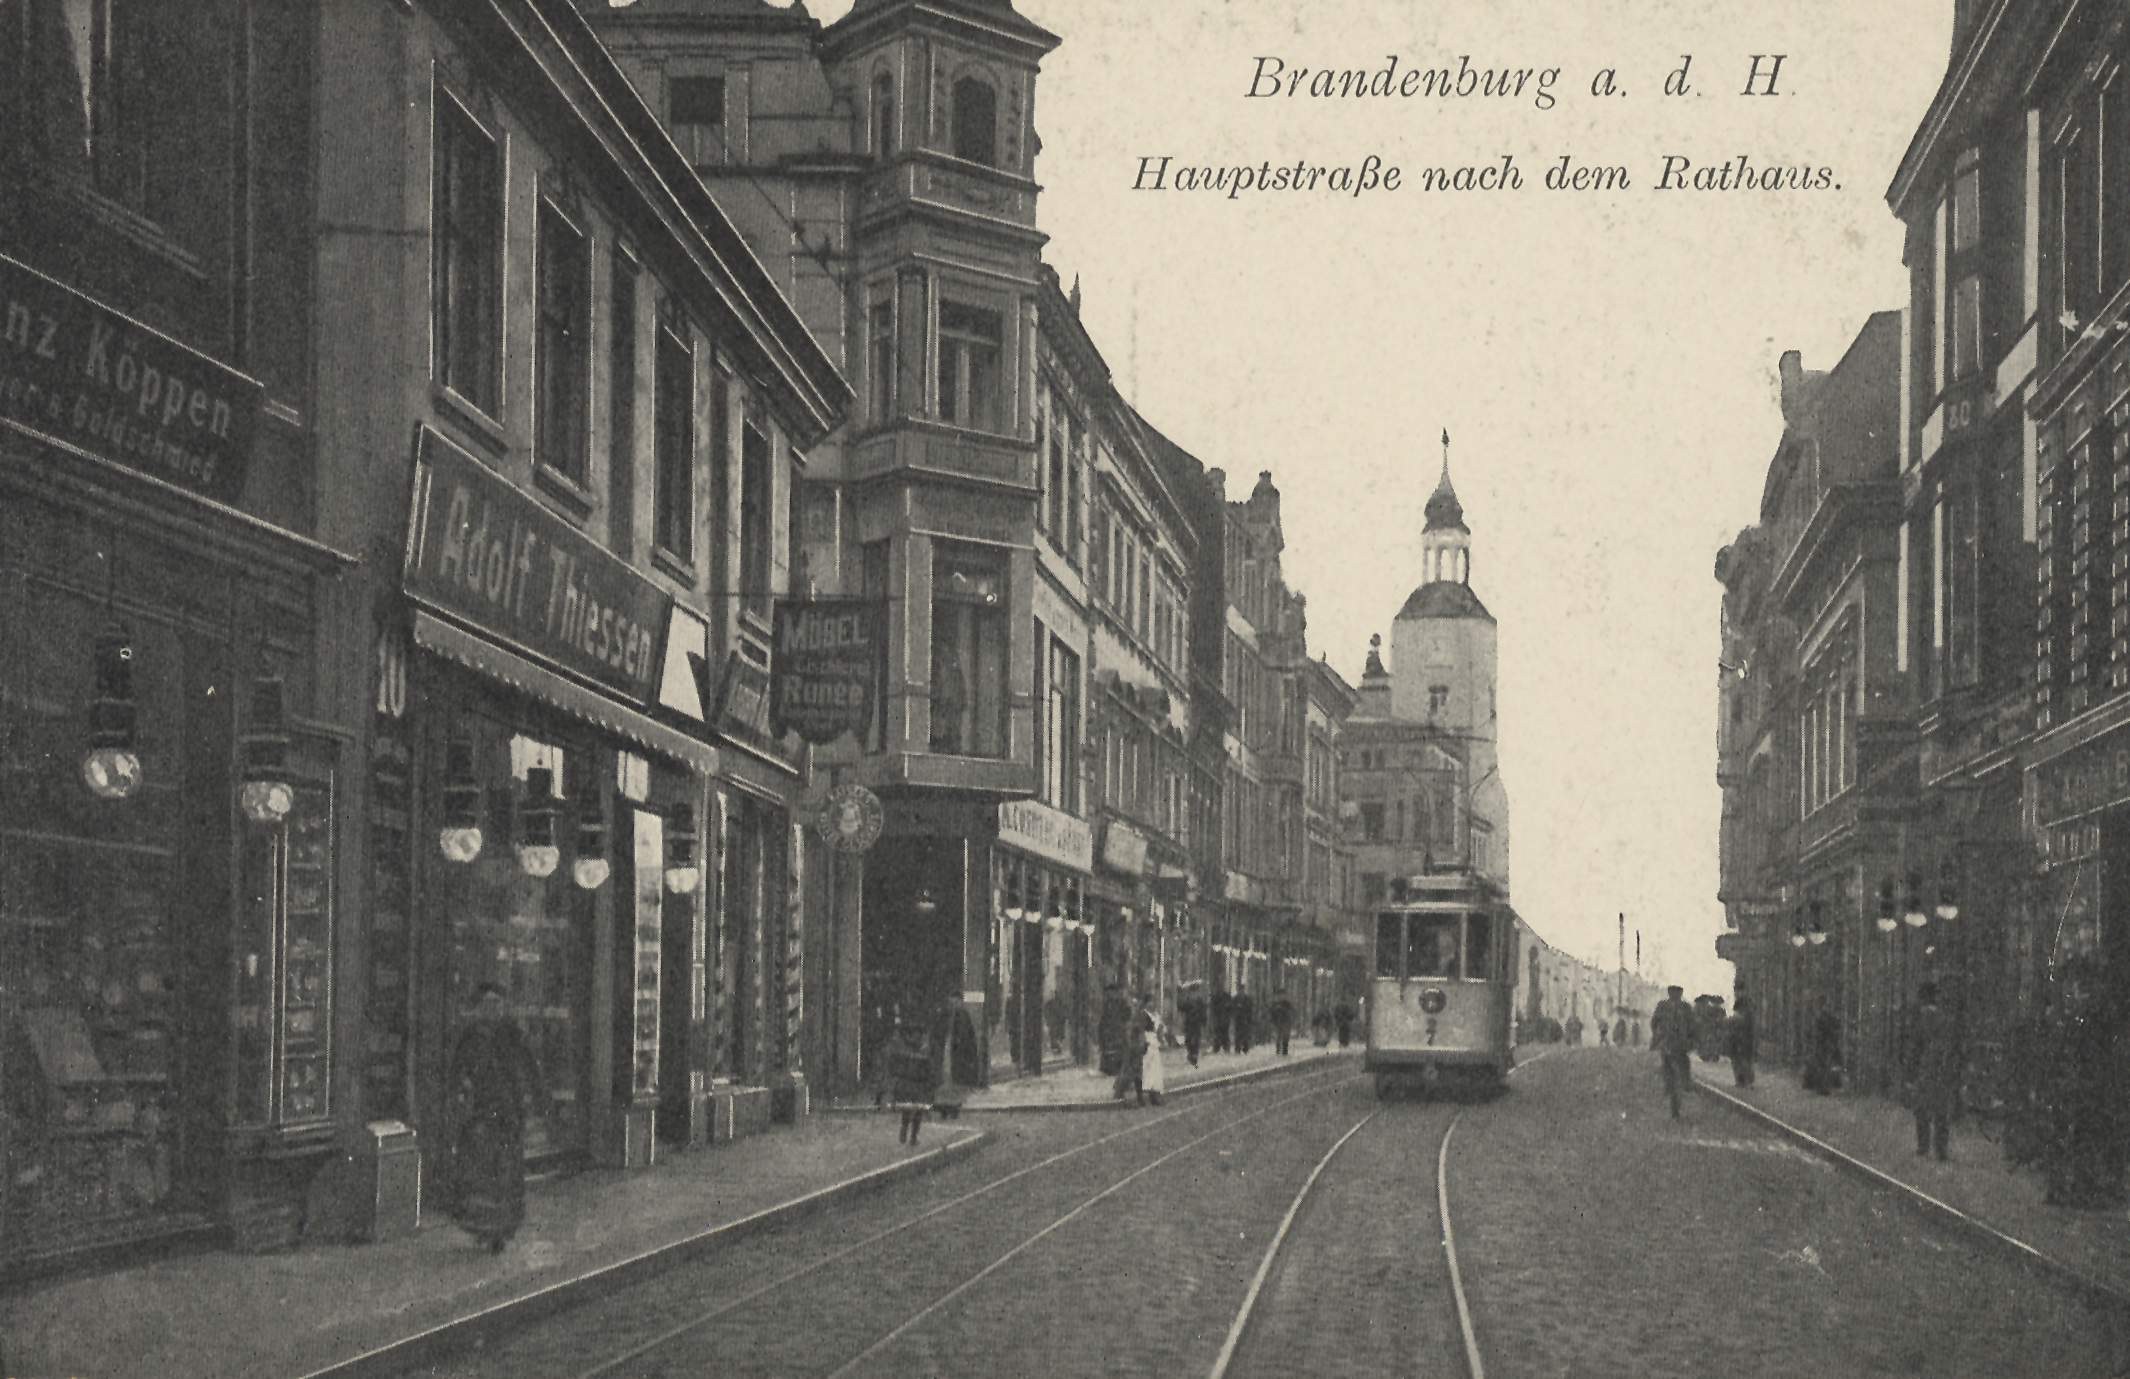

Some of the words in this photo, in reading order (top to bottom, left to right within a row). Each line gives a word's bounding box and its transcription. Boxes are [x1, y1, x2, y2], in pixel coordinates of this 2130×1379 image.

[84, 320, 233, 440] Köppen
[440, 486, 537, 618] Adolf
[546, 543, 654, 683] Thiessen
